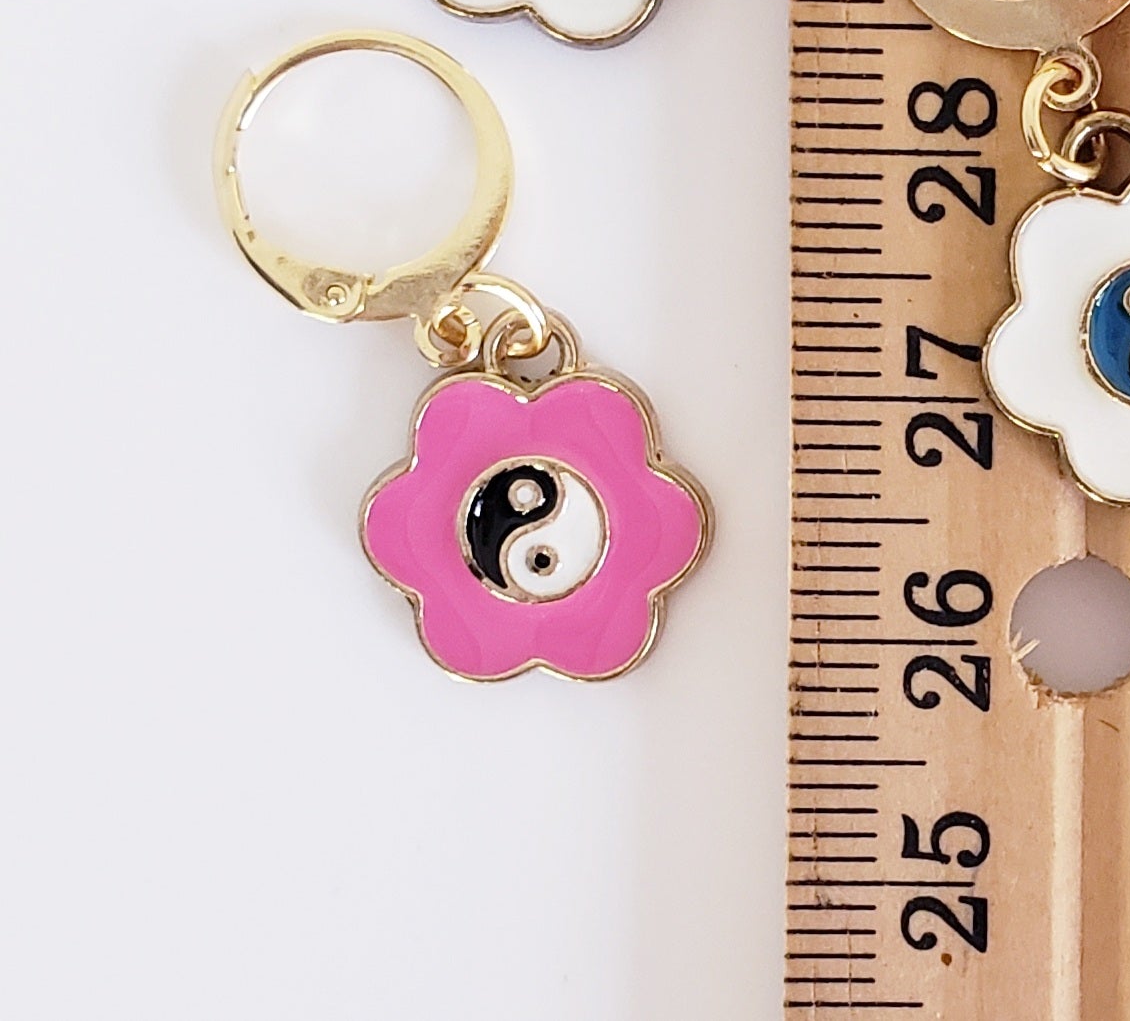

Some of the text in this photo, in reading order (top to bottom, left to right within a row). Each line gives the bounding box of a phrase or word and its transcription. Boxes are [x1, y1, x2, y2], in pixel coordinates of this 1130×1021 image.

[907, 77, 998, 225] 28
[905, 325, 993, 470] 27
[903, 569, 993, 713] 26
[900, 811, 990, 953] 25
